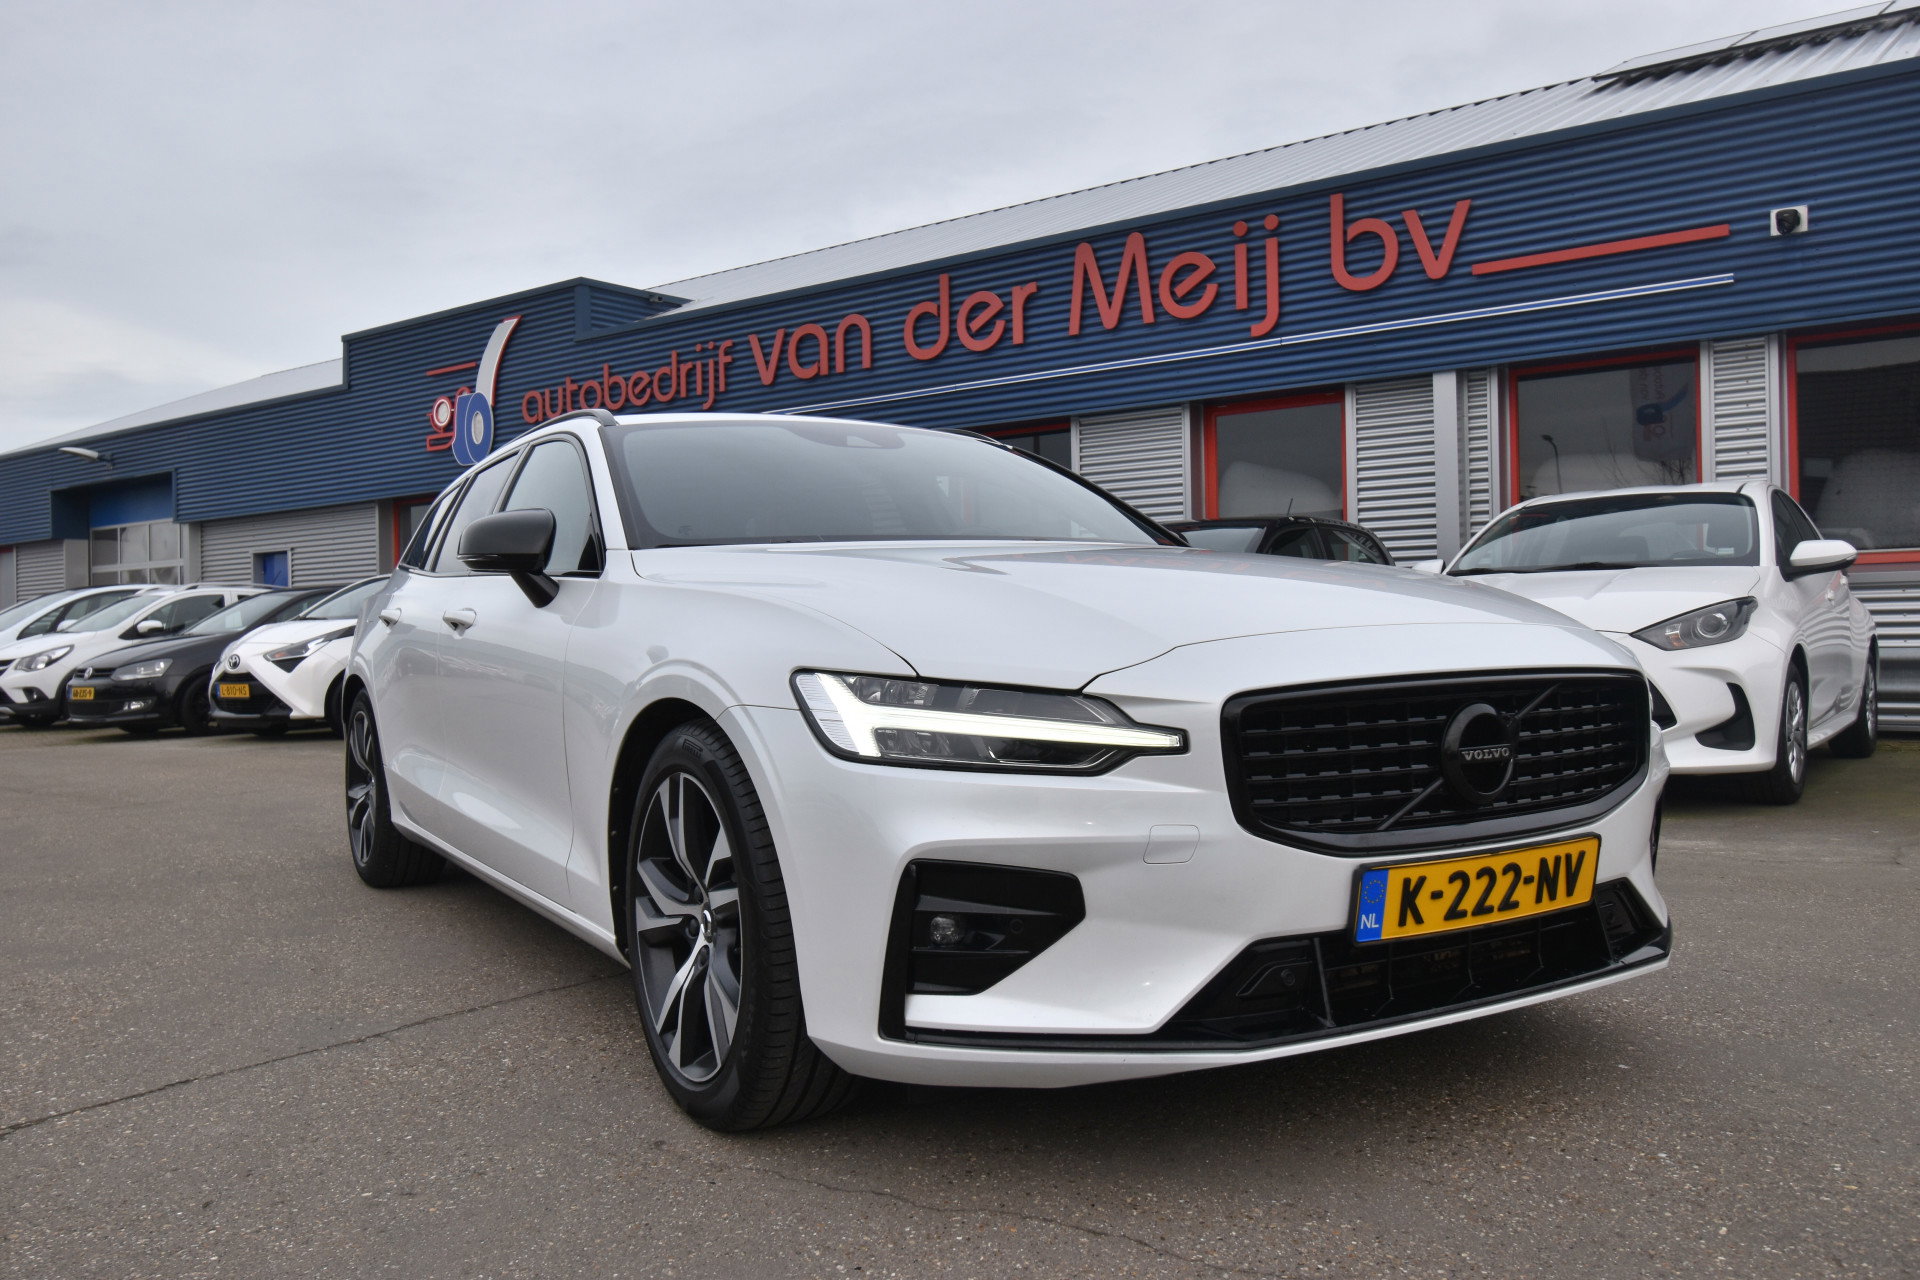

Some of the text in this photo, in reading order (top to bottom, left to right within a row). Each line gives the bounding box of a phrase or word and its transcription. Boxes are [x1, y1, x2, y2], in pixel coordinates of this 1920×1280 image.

[521, 193, 1472, 424] autobedrijf van der Meij bv
[1461, 747, 1511, 760] VOLVO
[1397, 850, 1587, 928] K-222-NV
[1360, 912, 1380, 930] NL
